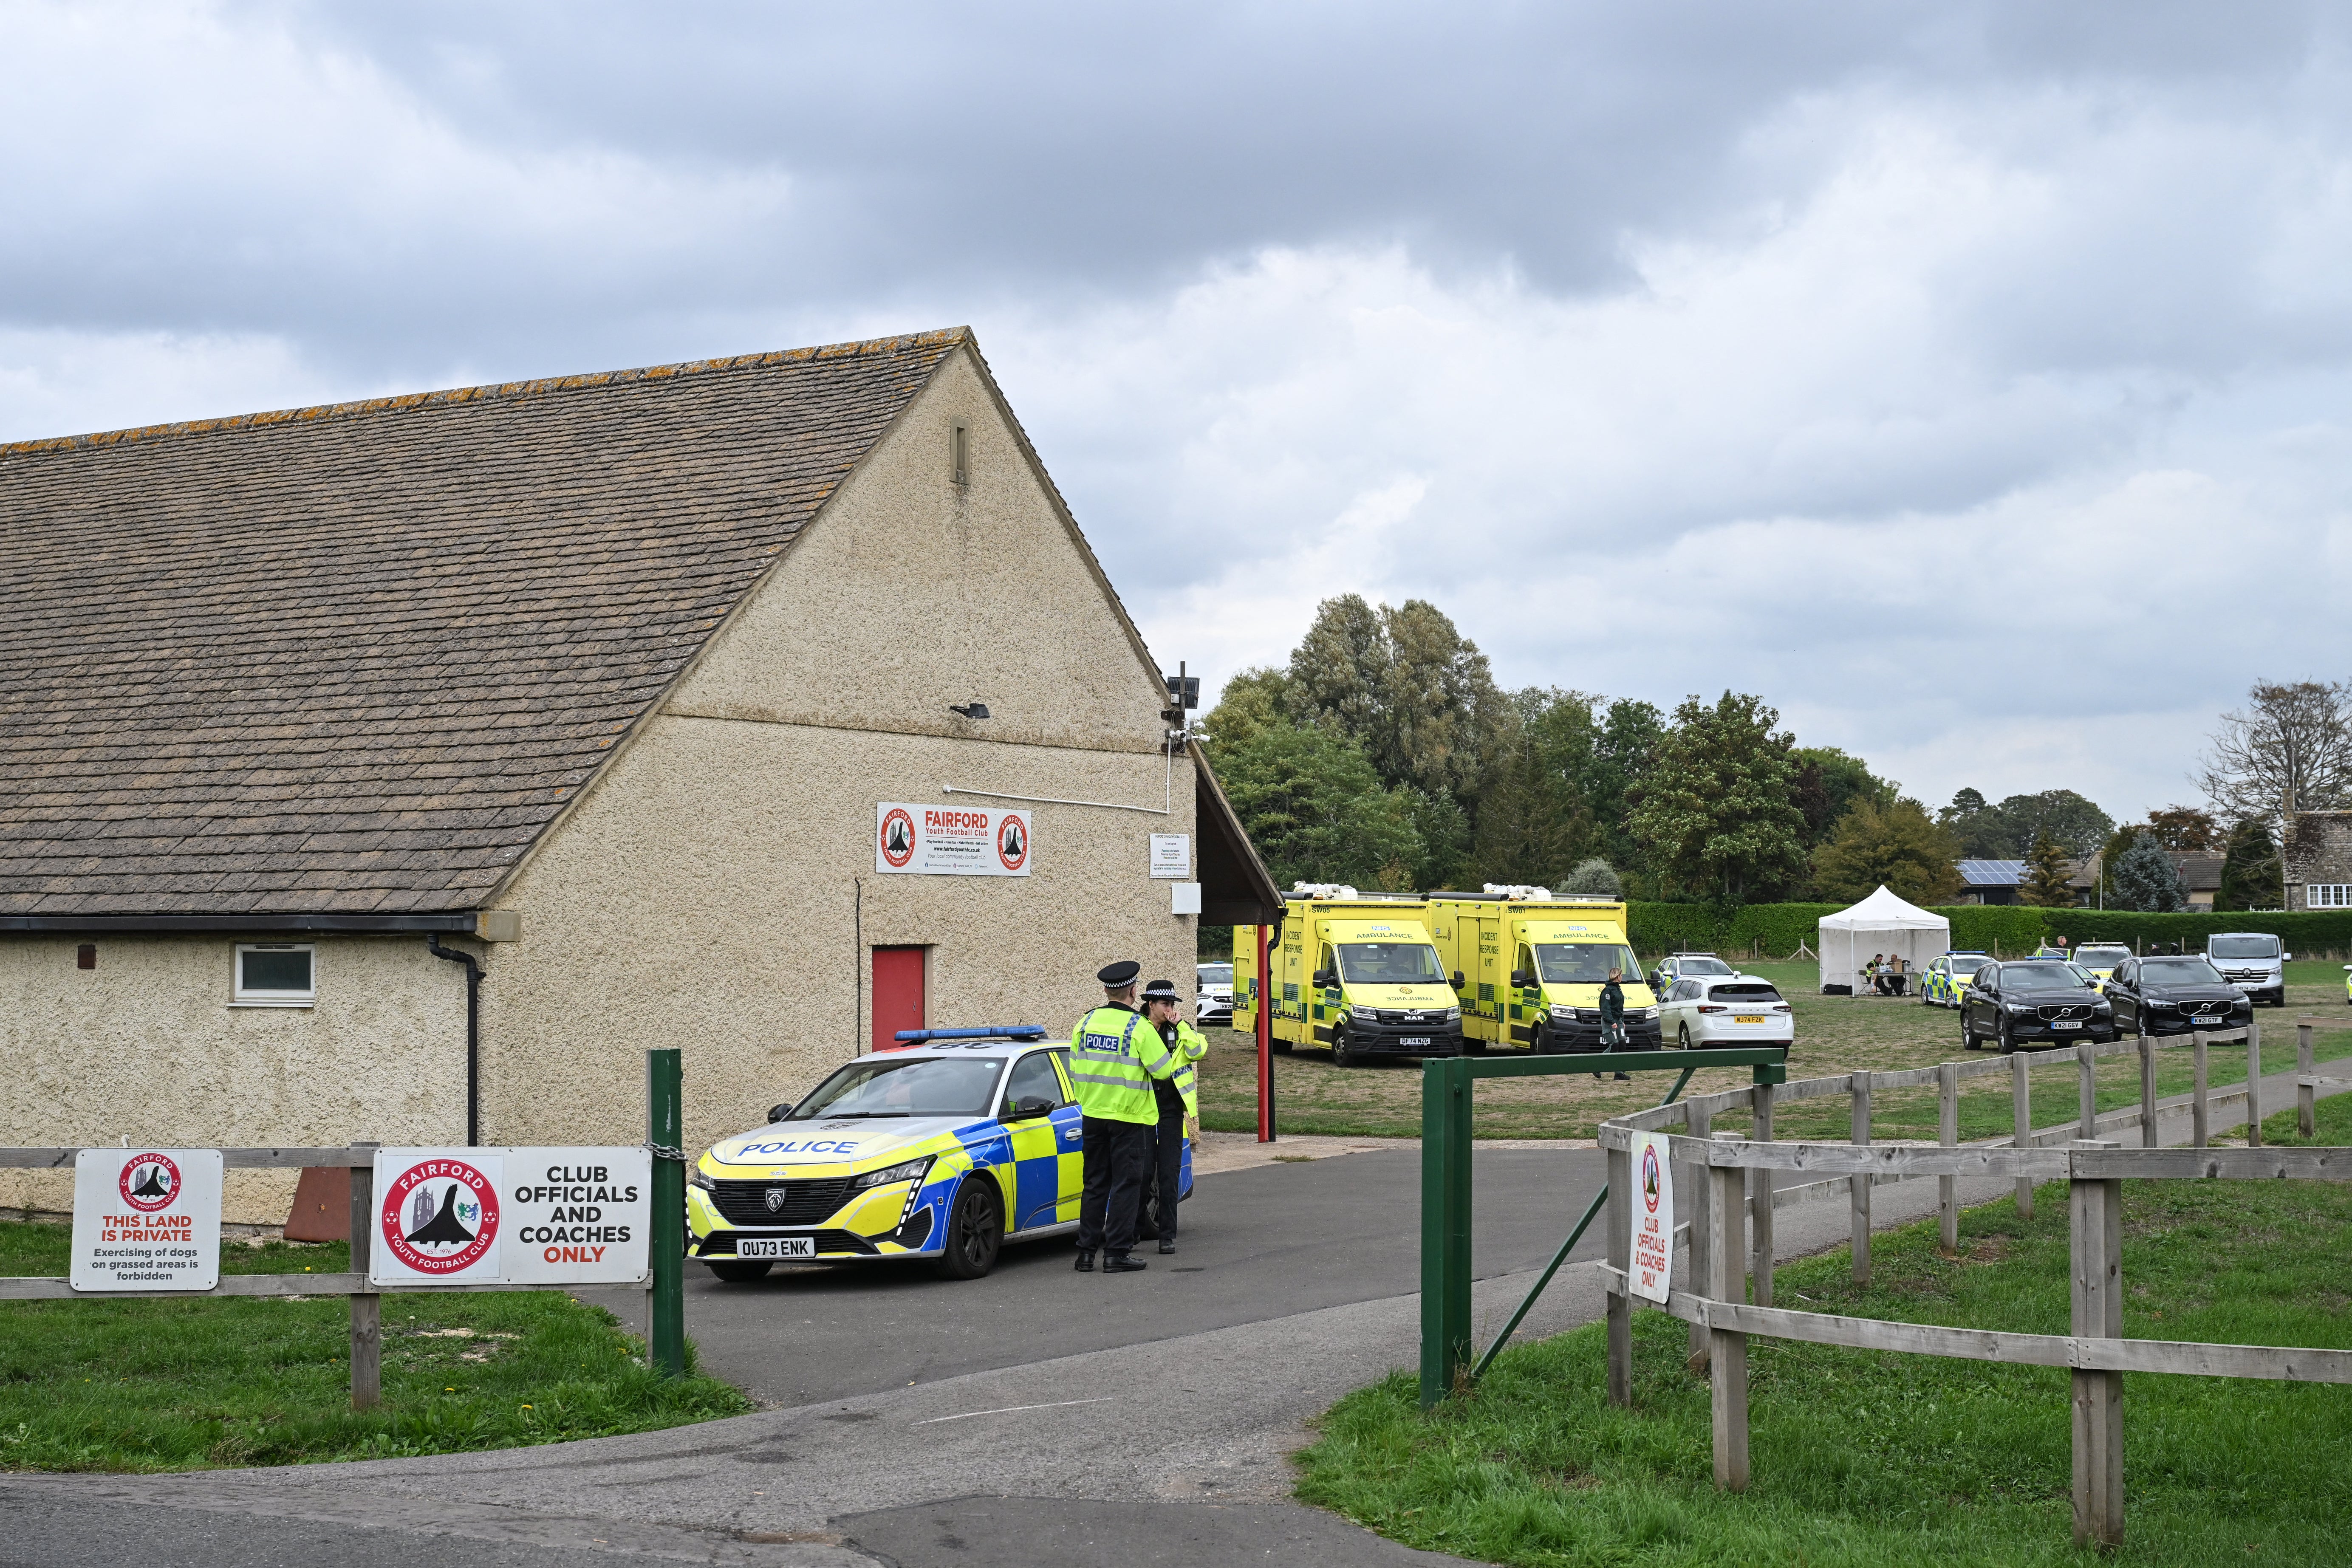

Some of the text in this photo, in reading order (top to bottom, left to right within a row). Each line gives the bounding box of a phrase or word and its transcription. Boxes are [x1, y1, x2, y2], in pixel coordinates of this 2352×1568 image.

[886, 811, 910, 824] FAIRFORD
[925, 811, 988, 829] FAIRFORD
[1002, 817, 1023, 830] FAIRFORD
[1286, 931, 1301, 941] INCIDENT
[1481, 932, 1498, 941] INCIDENT
[1285, 944, 1303, 954] RESPONSE
[1480, 944, 1499, 955] RESPONSE
[1289, 957, 1298, 966] UNIT
[1485, 958, 1493, 967] UNIT
[1086, 1036, 1117, 1049] POLICE
[737, 1141, 859, 1157] POLICE
[128, 1155, 173, 1169] FAIRFORD
[399, 1163, 483, 1190] FAIRFORD
[547, 1166, 608, 1182] CLUB
[124, 1191, 137, 1206] YOUTH
[165, 1191, 175, 1203] CLUB
[515, 1186, 638, 1203] OFFICIALS
[103, 1216, 192, 1227] THIS LAND
[550, 1206, 601, 1223] AND
[1645, 1217, 1658, 1233] CLUB
[102, 1230, 192, 1241] IS PRIVATE
[520, 1226, 630, 1243] COACHES
[743, 1240, 808, 1256] OU73 ENK
[1638, 1233, 1665, 1254] OFFICIALS
[94, 1248, 197, 1258] Exercising of dogs
[392, 1233, 489, 1269] YOUTH FOOTBALL CLUB
[544, 1246, 606, 1263] ONLY
[109, 1260, 153, 1270] grassed
[189, 1260, 198, 1268] is
[1636, 1250, 1665, 1273] & COACHES
[117, 1271, 172, 1280] forbidden
[1642, 1270, 1656, 1288] ONLY
